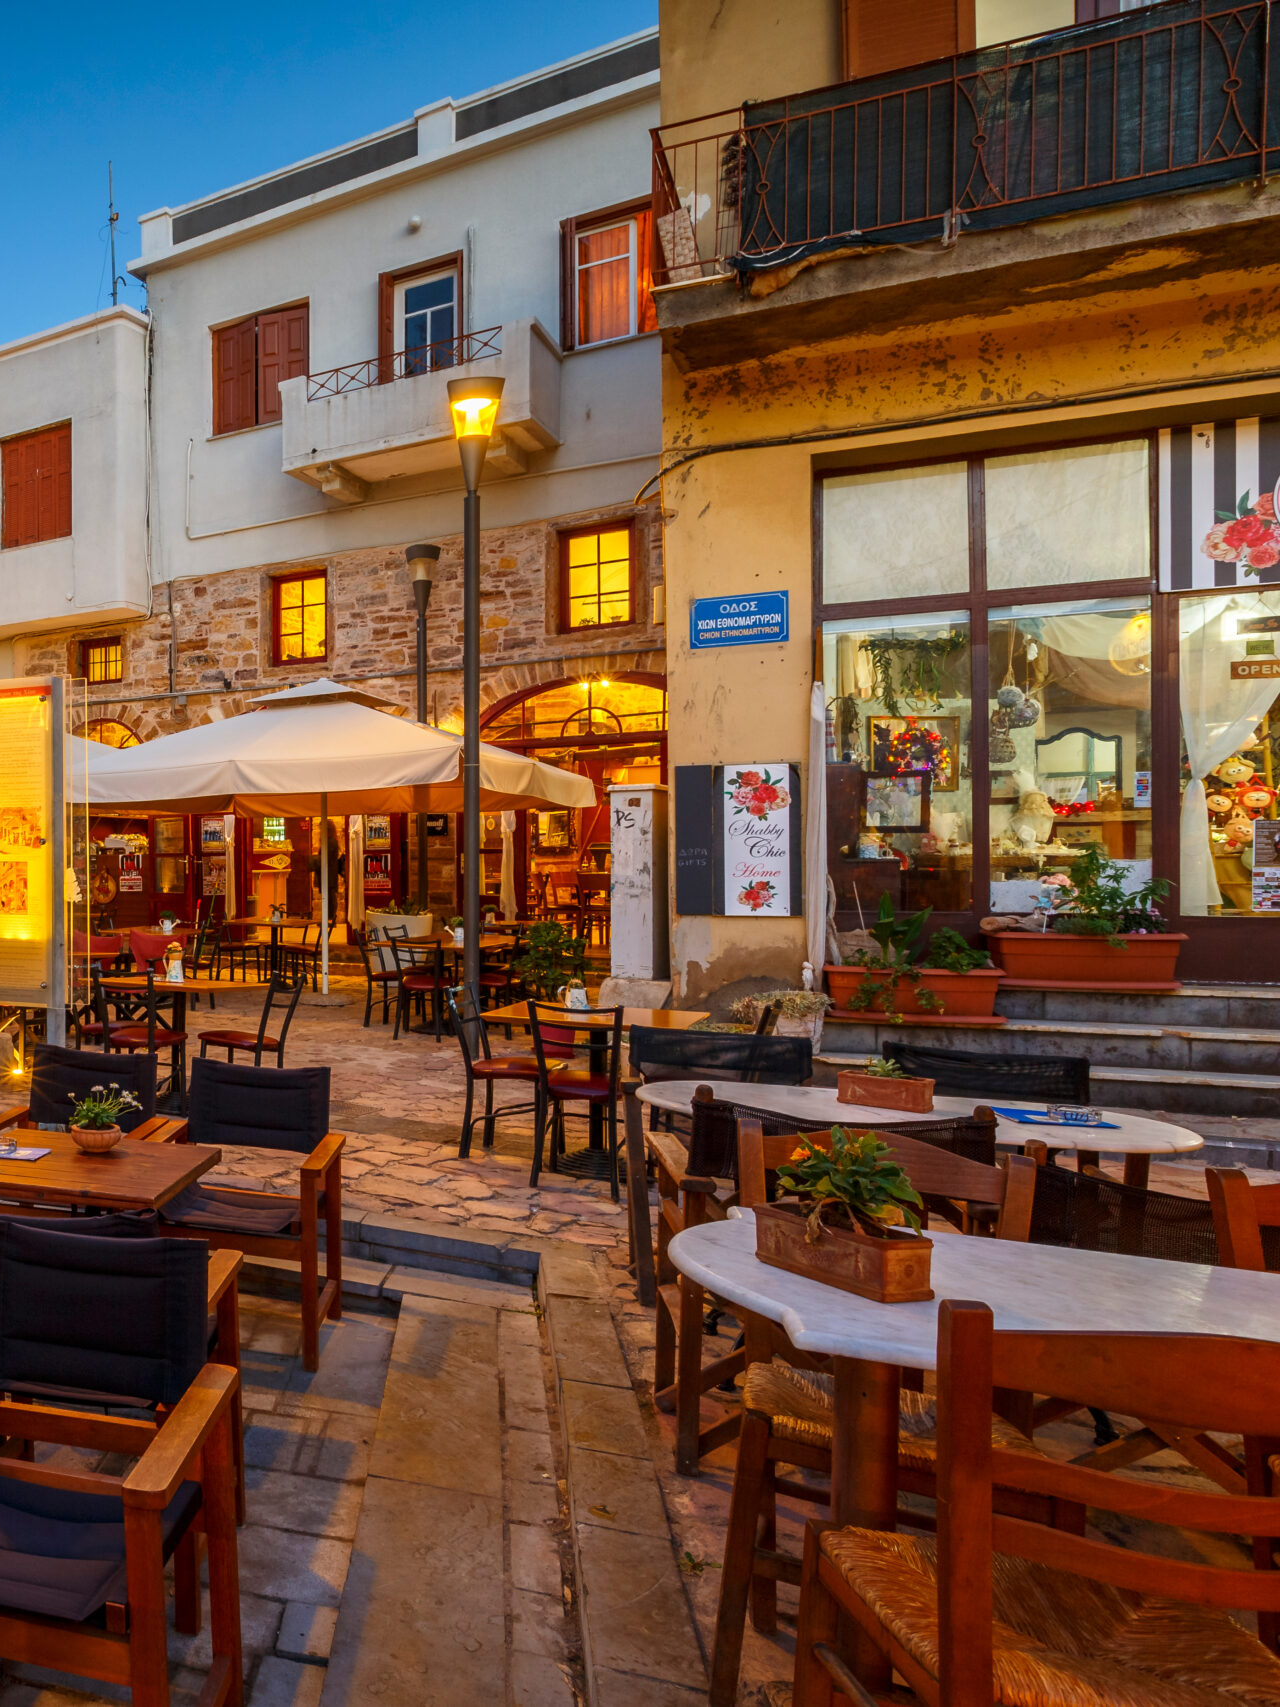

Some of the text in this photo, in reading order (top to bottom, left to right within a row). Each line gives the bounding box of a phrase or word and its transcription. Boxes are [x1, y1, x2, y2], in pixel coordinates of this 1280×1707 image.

[719, 601, 758, 614] ΟΔΟΣ
[697, 613, 782, 630] ΧΙΩΝ ΕΘΝΟΜΑΡΤΥΡΩΝ
[699, 626, 780, 640] CHION ETHNOMARTYRON
[728, 819, 785, 841] Shabby
[744, 836, 786, 858] Chic
[732, 861, 782, 878] Home
